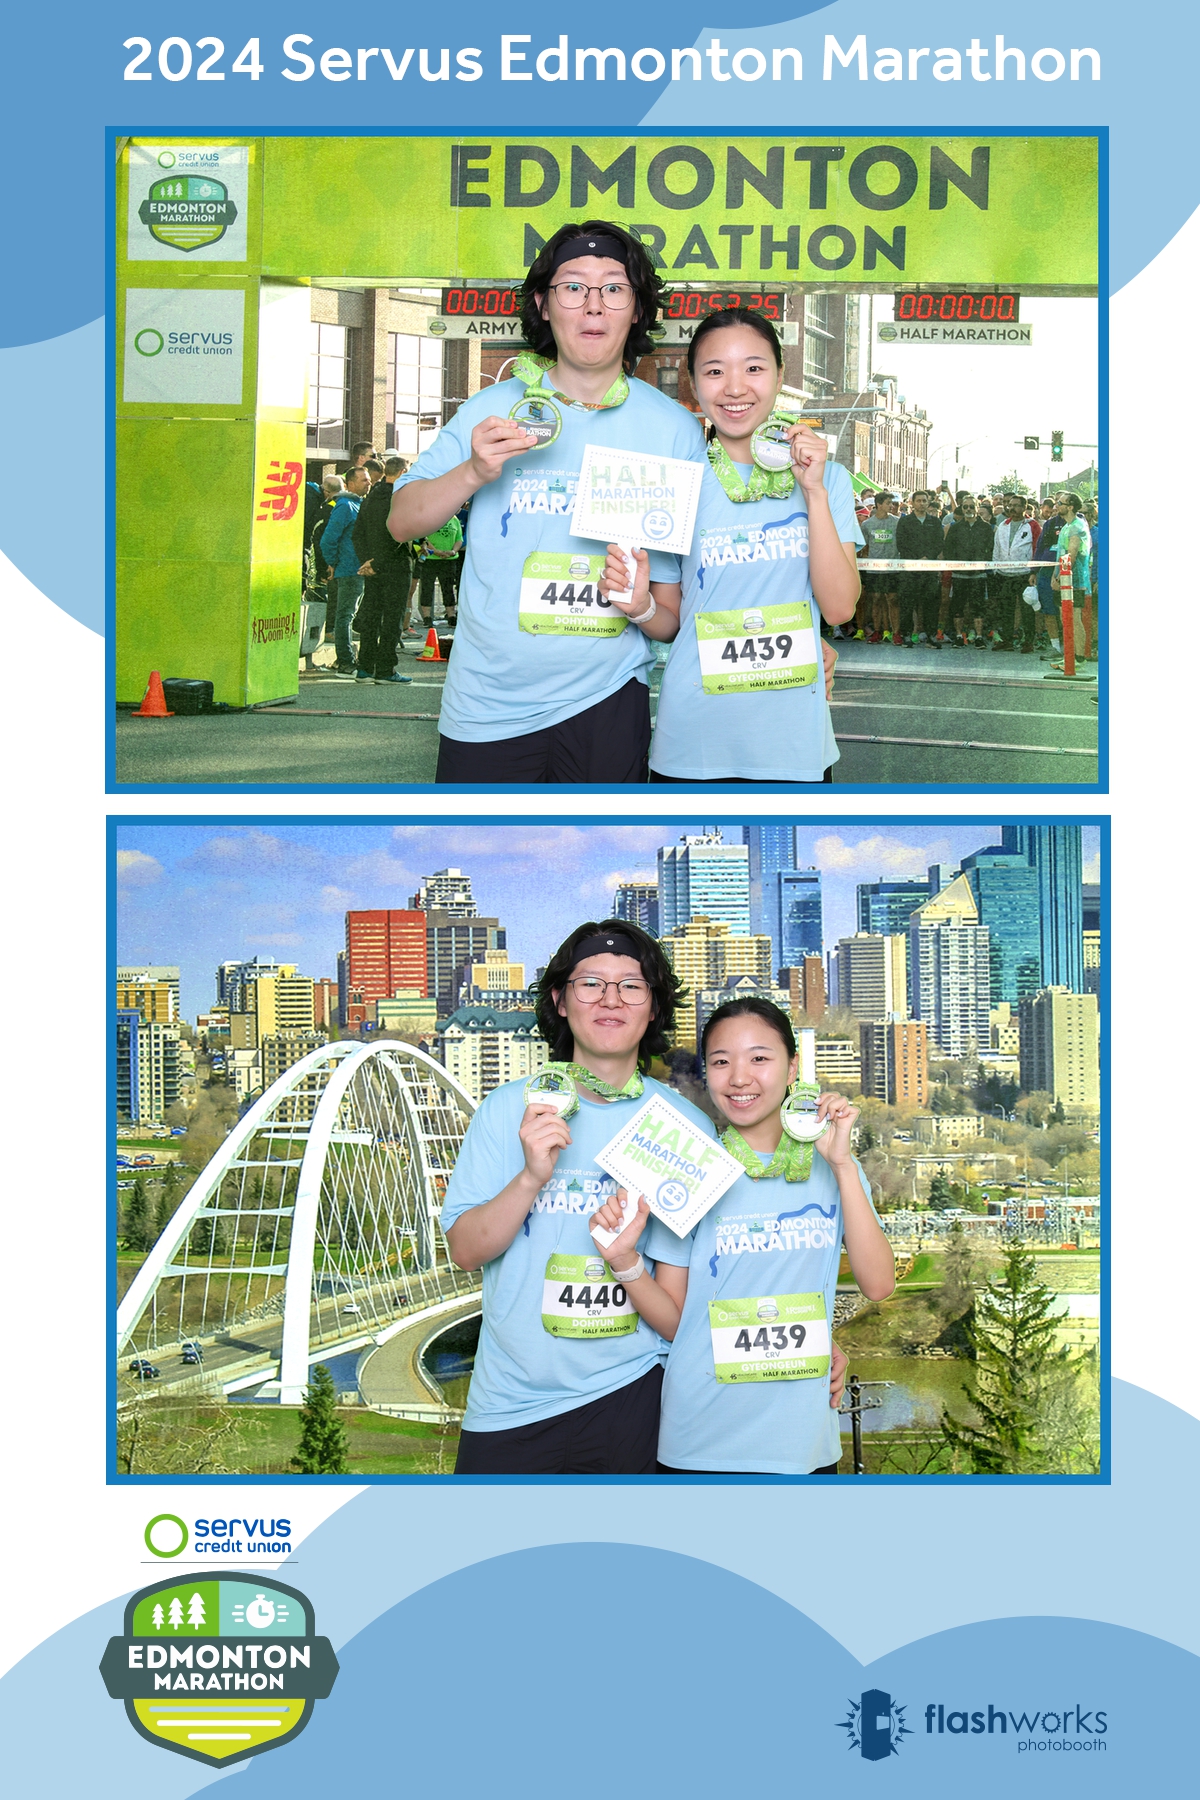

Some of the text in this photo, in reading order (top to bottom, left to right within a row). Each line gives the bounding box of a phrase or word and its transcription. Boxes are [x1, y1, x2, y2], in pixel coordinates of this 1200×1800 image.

[178, 152, 219, 161] servus
[450, 144, 990, 211] EDMONTON
[149, 202, 227, 214] EDMONTON
[160, 214, 216, 222] MARATHON
[522, 223, 906, 270] MRATHON
[466, 321, 518, 335] ARMY
[900, 328, 939, 340] HALF
[943, 328, 1031, 341] MARATHON
[168, 332, 233, 345] servus
[168, 345, 233, 355] credit union
[512, 478, 548, 492] 2024
[591, 487, 675, 499] MARATHON
[508, 491, 578, 516] MARA
[707, 526, 726, 534] servus
[727, 524, 745, 532] credit
[700, 525, 809, 549] 2024 EDMONT
[701, 538, 809, 569] MARATHO
[554, 616, 598, 626] DOHYUN
[721, 634, 793, 663] 4439
[728, 668, 793, 683] GYEONGEUN
[767, 676, 806, 687] MARATHON
[637, 1113, 720, 1168] HALF
[631, 1132, 708, 1181] MARATHON
[563, 1168, 582, 1176] credit
[622, 1142, 702, 1195] FINISHER!
[541, 1178, 567, 1192] 024
[722, 1211, 777, 1221] servus credit union
[715, 1216, 837, 1236] 2024 EDMONTON
[716, 1228, 836, 1256] MARATHON
[558, 1283, 627, 1309] 4440
[572, 1318, 615, 1327] DOHYUN
[600, 1325, 631, 1333] MARATHON
[734, 1324, 807, 1352] 4439
[741, 1359, 806, 1372] GYEONGEUN
[780, 1367, 819, 1376] MARATHON
